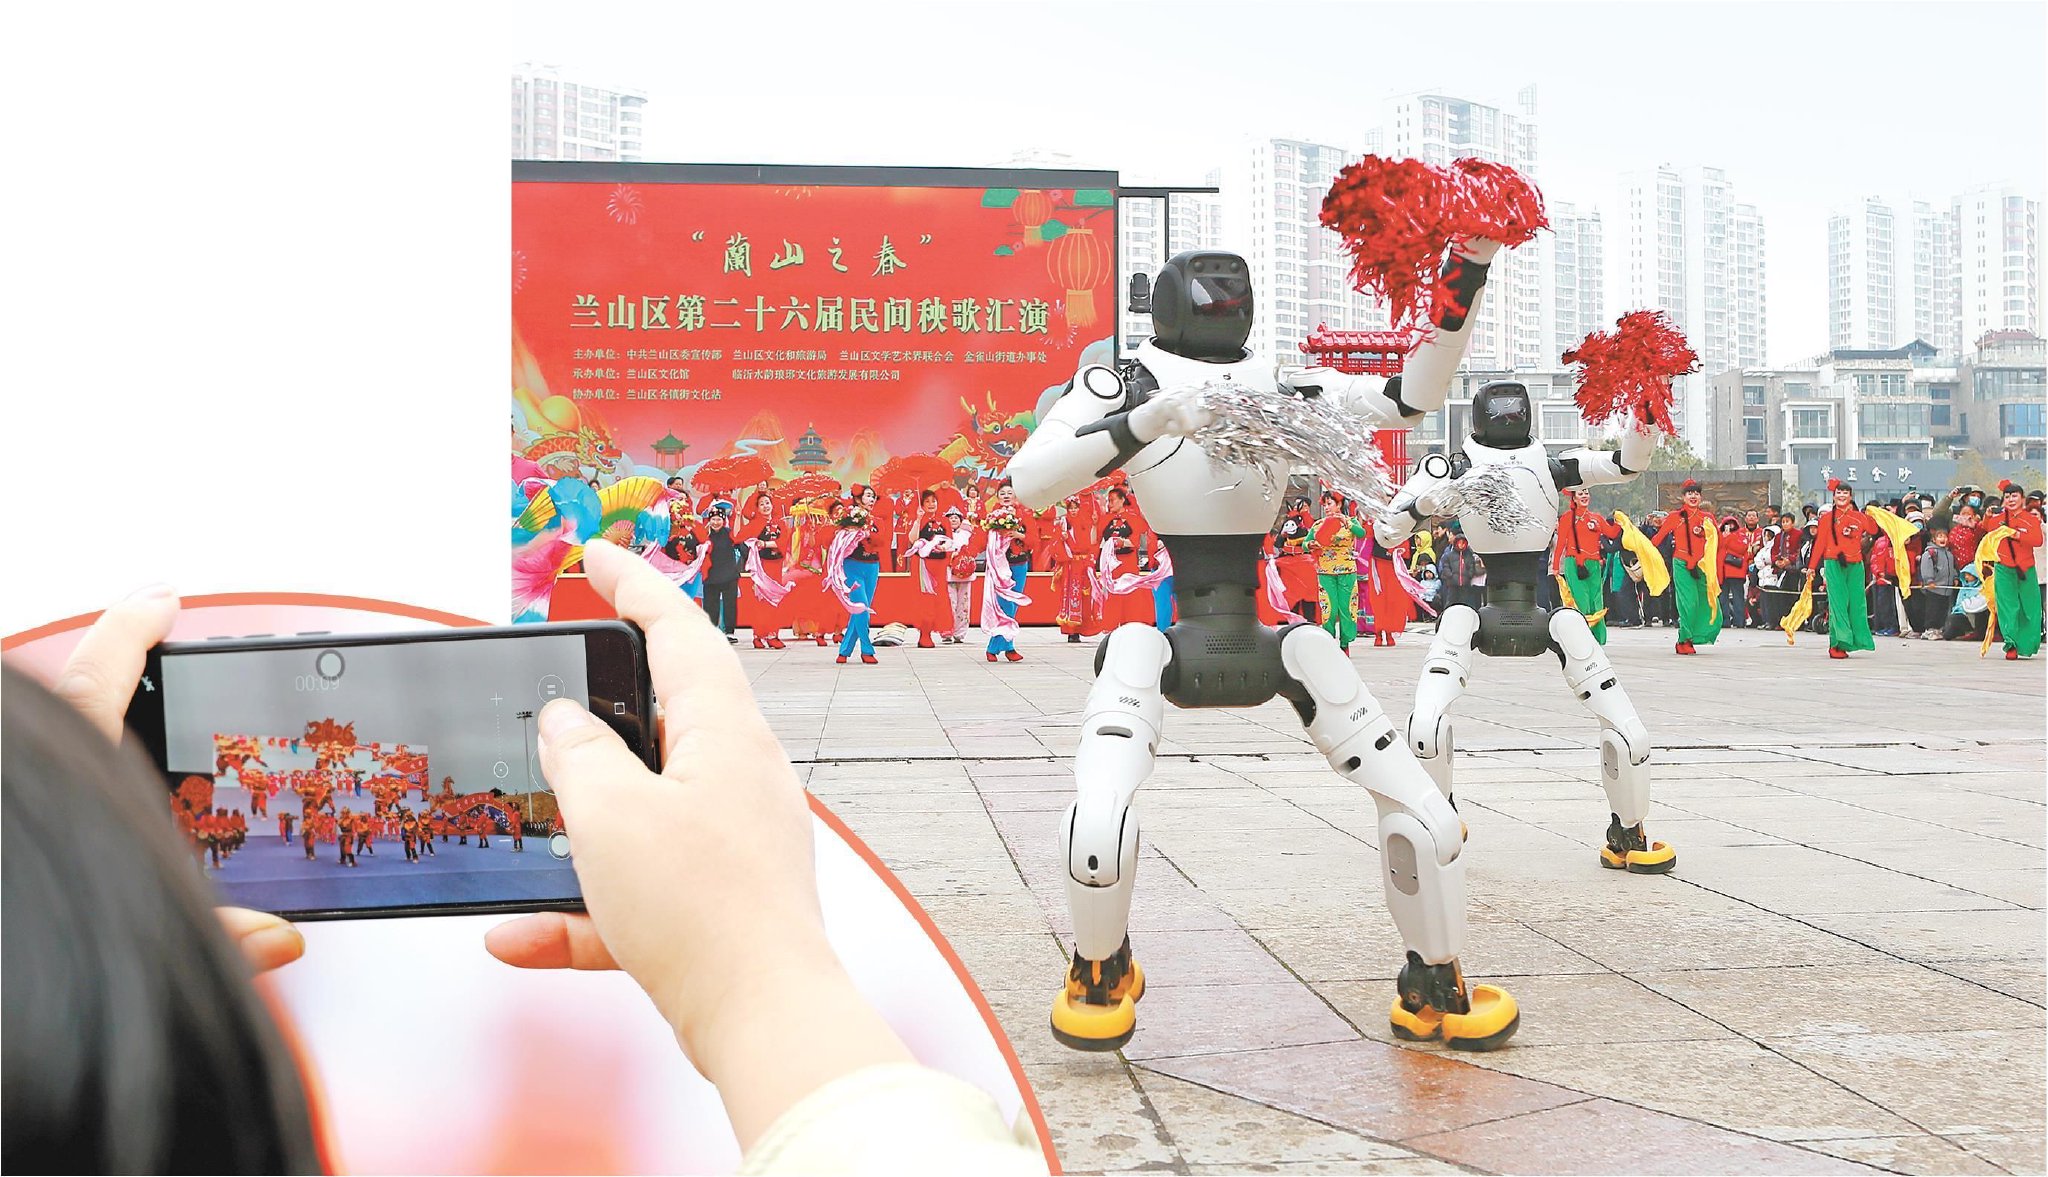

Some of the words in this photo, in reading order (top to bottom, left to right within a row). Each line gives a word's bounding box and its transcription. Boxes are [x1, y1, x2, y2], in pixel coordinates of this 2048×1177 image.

[570, 294, 1050, 335] 兰山区第二十六届民间秧歌汇演
[732, 349, 828, 362] 兰山区文化和旅游局
[839, 350, 955, 363] 兰山区文学艺术界联合会
